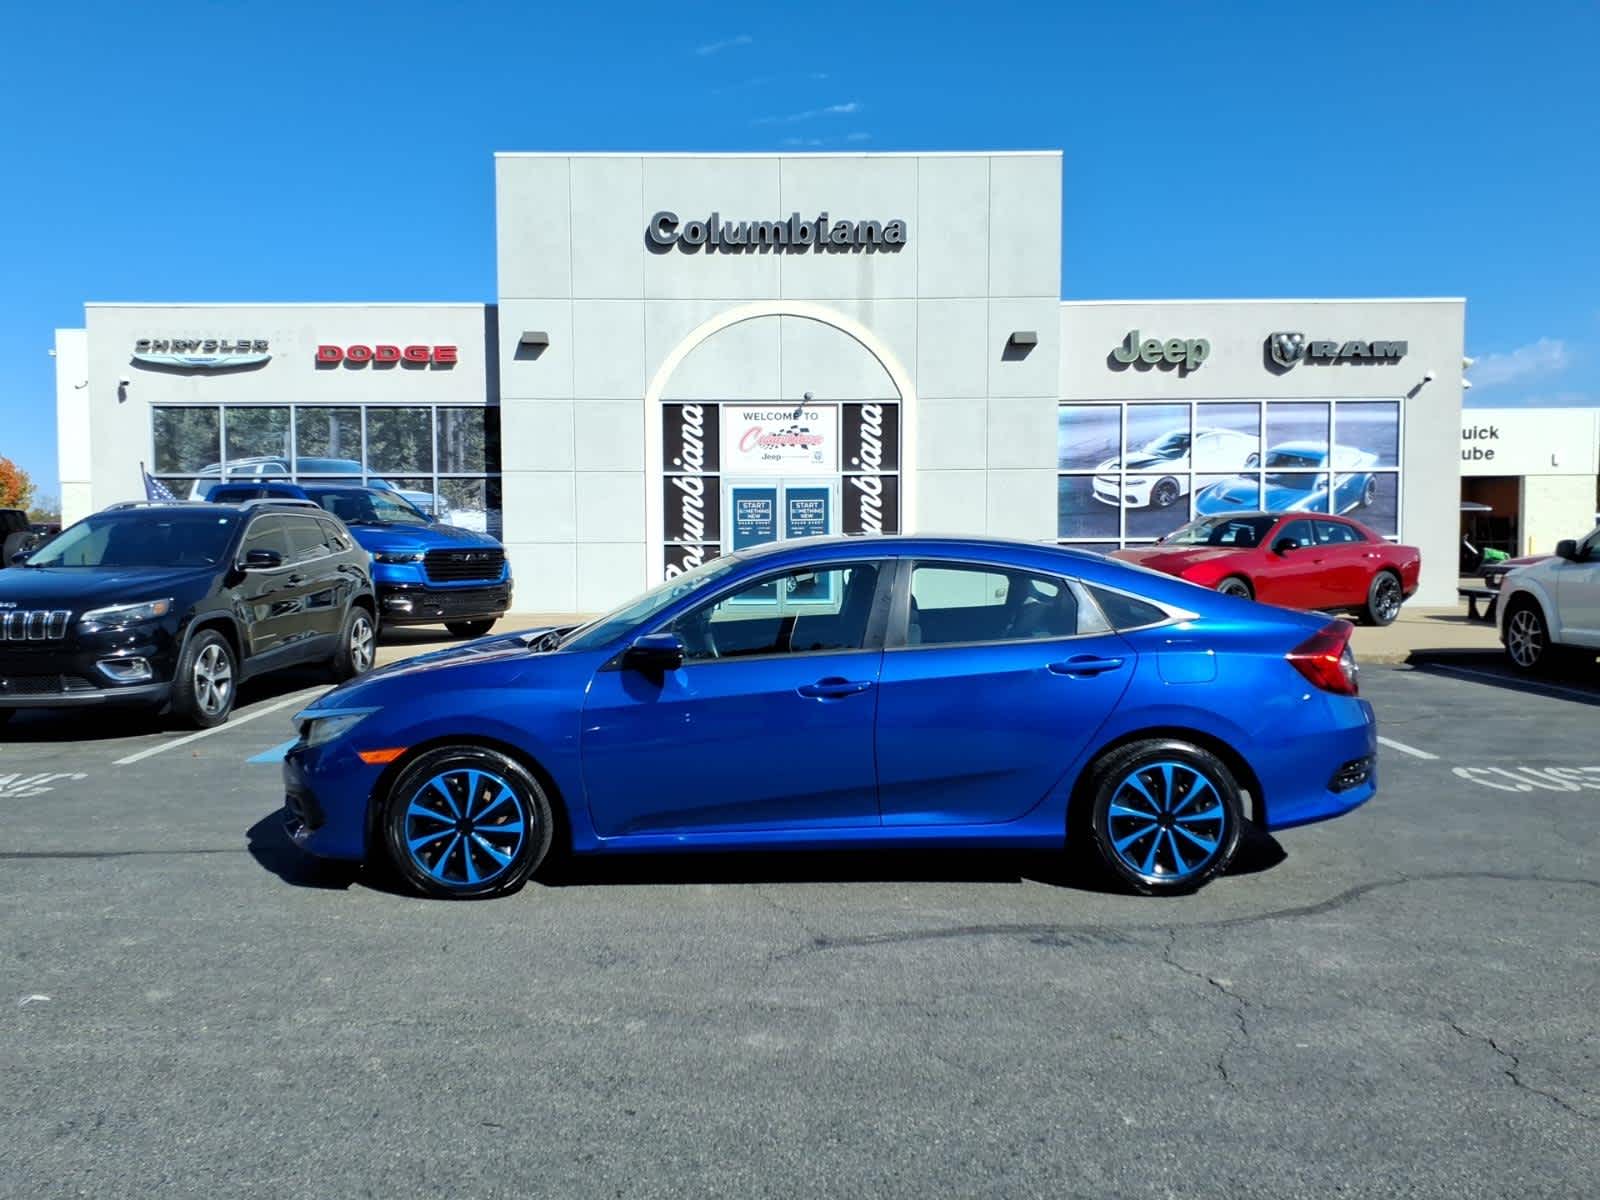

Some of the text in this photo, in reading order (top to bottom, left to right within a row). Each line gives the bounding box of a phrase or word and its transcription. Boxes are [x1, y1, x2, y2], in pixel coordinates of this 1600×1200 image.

[648, 211, 907, 248] Columbiana
[134, 338, 270, 353] CHRYSLER
[316, 344, 458, 363] DODGE
[1112, 329, 1211, 369] Jeep
[1310, 340, 1408, 359] RAM
[804, 412, 819, 421] TO
[761, 453, 782, 462] Jeep
